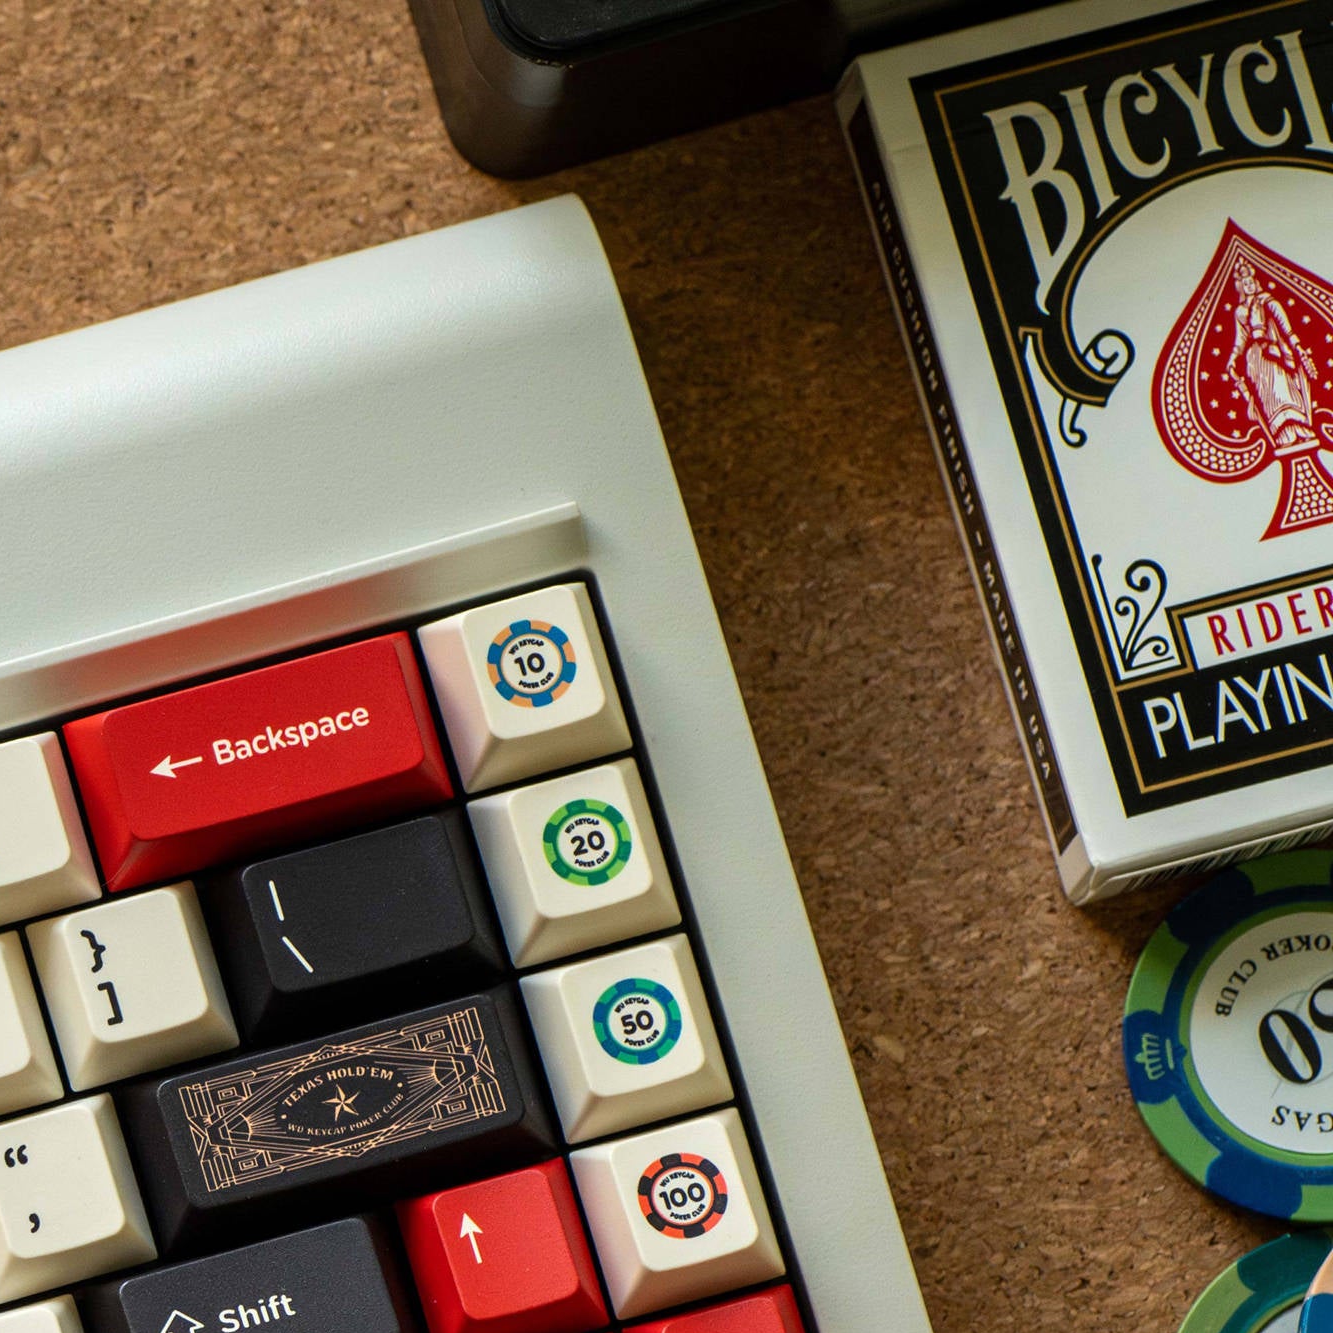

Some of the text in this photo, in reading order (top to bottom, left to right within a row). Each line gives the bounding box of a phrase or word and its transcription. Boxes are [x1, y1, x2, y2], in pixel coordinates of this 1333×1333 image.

[983, 29, 1333, 315] BICYCL
[937, 403, 974, 515] FINISH
[983, 561, 1015, 655] MADE
[1014, 666, 1029, 701] IN
[1028, 714, 1051, 781] USA
[1207, 586, 1333, 656] RIDER
[514, 652, 545, 676] 10
[212, 706, 370, 766] Backspace
[570, 830, 605, 856] 20
[1215, 934, 1333, 1017] OKER CLUB
[620, 1010, 654, 1035] 50
[282, 1074, 324, 1107] TEXAS
[349, 1111, 383, 1131] POKER
[382, 1093, 404, 1114] CLUB
[659, 1182, 705, 1210] 100
[218, 1294, 297, 1333] Shift
